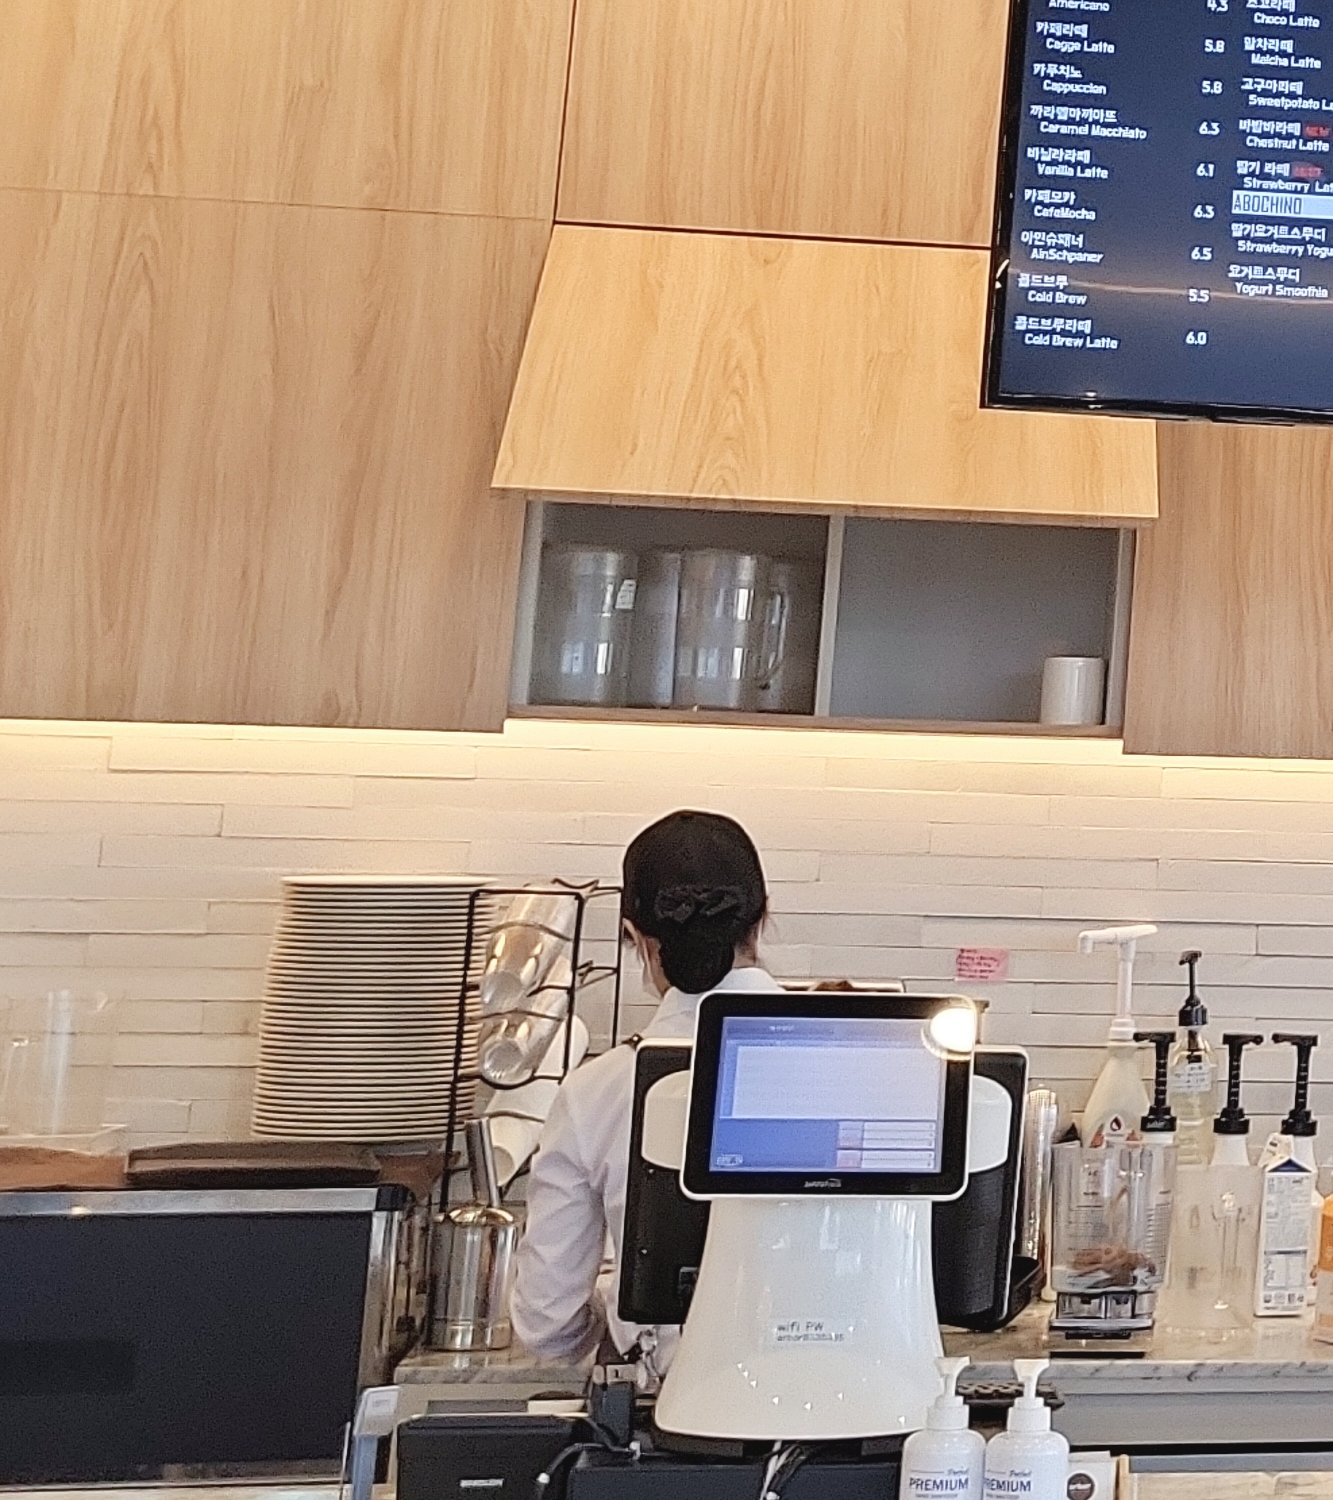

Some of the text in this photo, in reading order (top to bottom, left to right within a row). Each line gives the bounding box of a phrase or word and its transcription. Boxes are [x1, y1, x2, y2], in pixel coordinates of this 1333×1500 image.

[1254, 12, 1287, 25] Choco
[1197, 164, 1214, 176] 6.1
[1244, 177, 1310, 193] Strawberry
[1234, 195, 1302, 214] ABOCHINO
[1191, 247, 1211, 260] 6.5
[1238, 240, 1304, 257] Strawberry
[1028, 290, 1053, 302] Cold
[1055, 292, 1087, 304] Brew
[1025, 334, 1050, 345] Cold
[1052, 335, 1083, 347] Brew
[1186, 332, 1206, 344] 6.0
[777, 1322, 800, 1332] wifi
[909, 1477, 969, 1491] PREMIUM
[984, 1478, 1031, 1492] REMIUM
